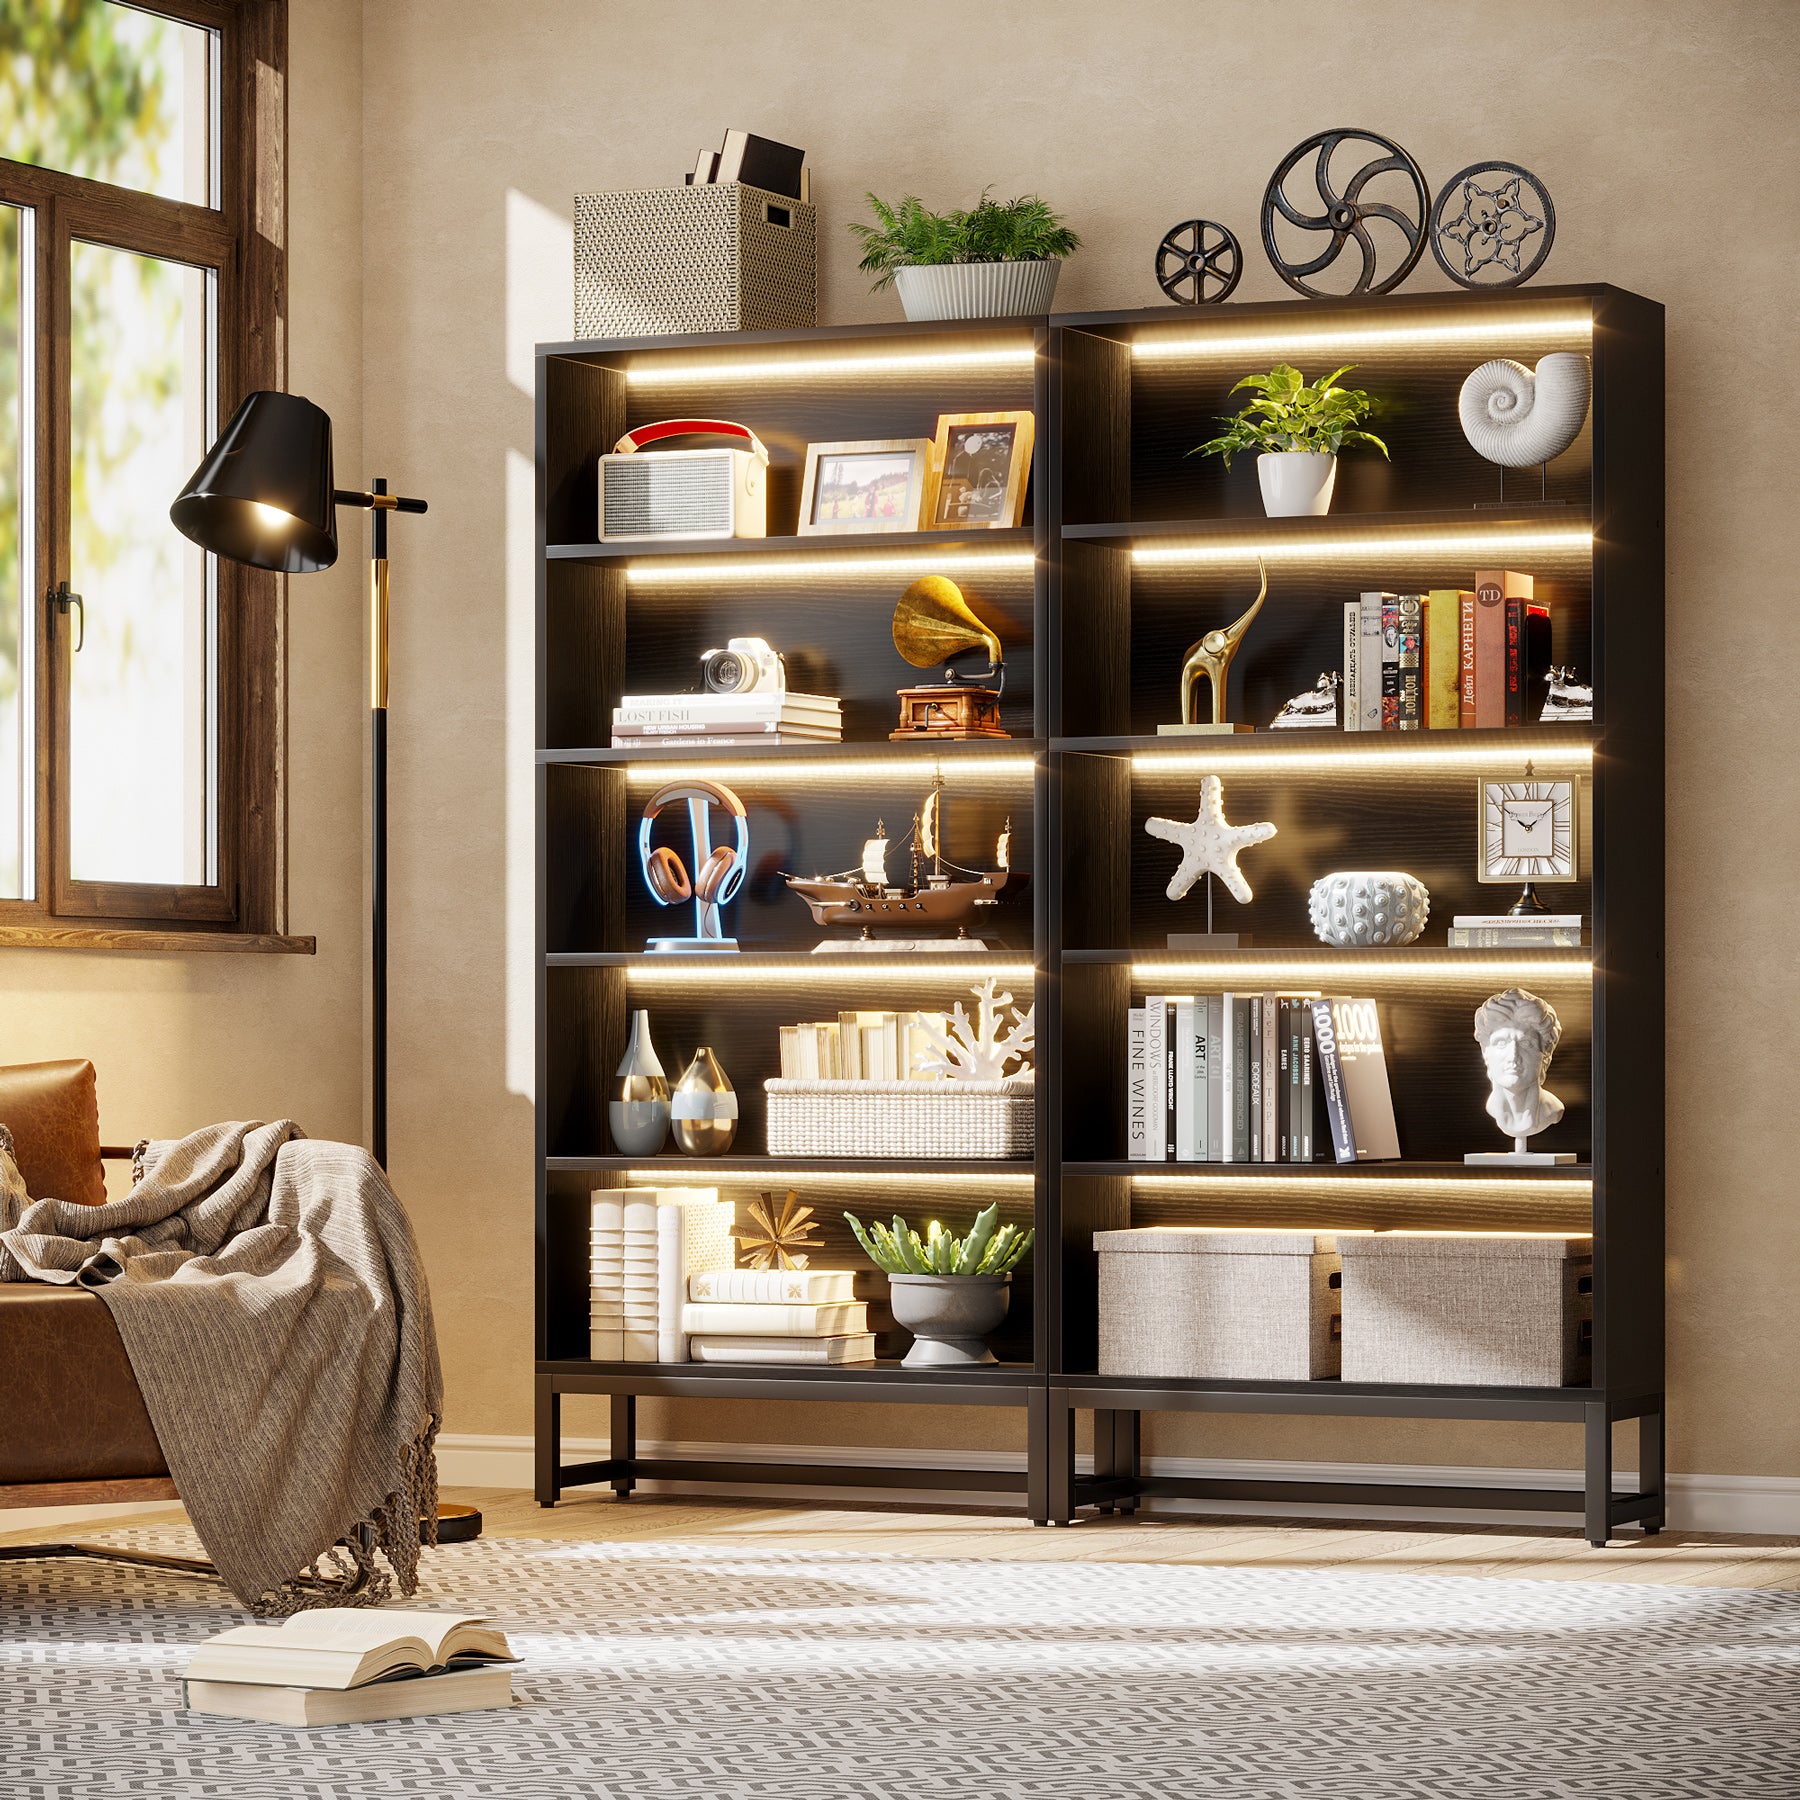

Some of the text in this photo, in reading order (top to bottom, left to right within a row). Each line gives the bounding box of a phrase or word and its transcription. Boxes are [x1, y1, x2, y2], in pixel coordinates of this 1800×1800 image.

[1480, 589, 1501, 602] TD
[1463, 601, 1475, 705] Дейл КАРНЕГИ
[619, 709, 690, 723] LOST FISH
[707, 736, 736, 745] France
[1150, 1001, 1162, 1069] WINDOWS
[1313, 1004, 1336, 1054] 1000
[1332, 1003, 1378, 1041] 1000
[1132, 1030, 1145, 1070] FINE
[1195, 1035, 1206, 1061] ART
[1210, 1035, 1222, 1061] ART
[1236, 1012, 1244, 1130] GRAPHIC DESIGN REFERENCED
[1252, 1062, 1260, 1105] BORDEAUX
[1132, 1079, 1145, 1140] WINES
